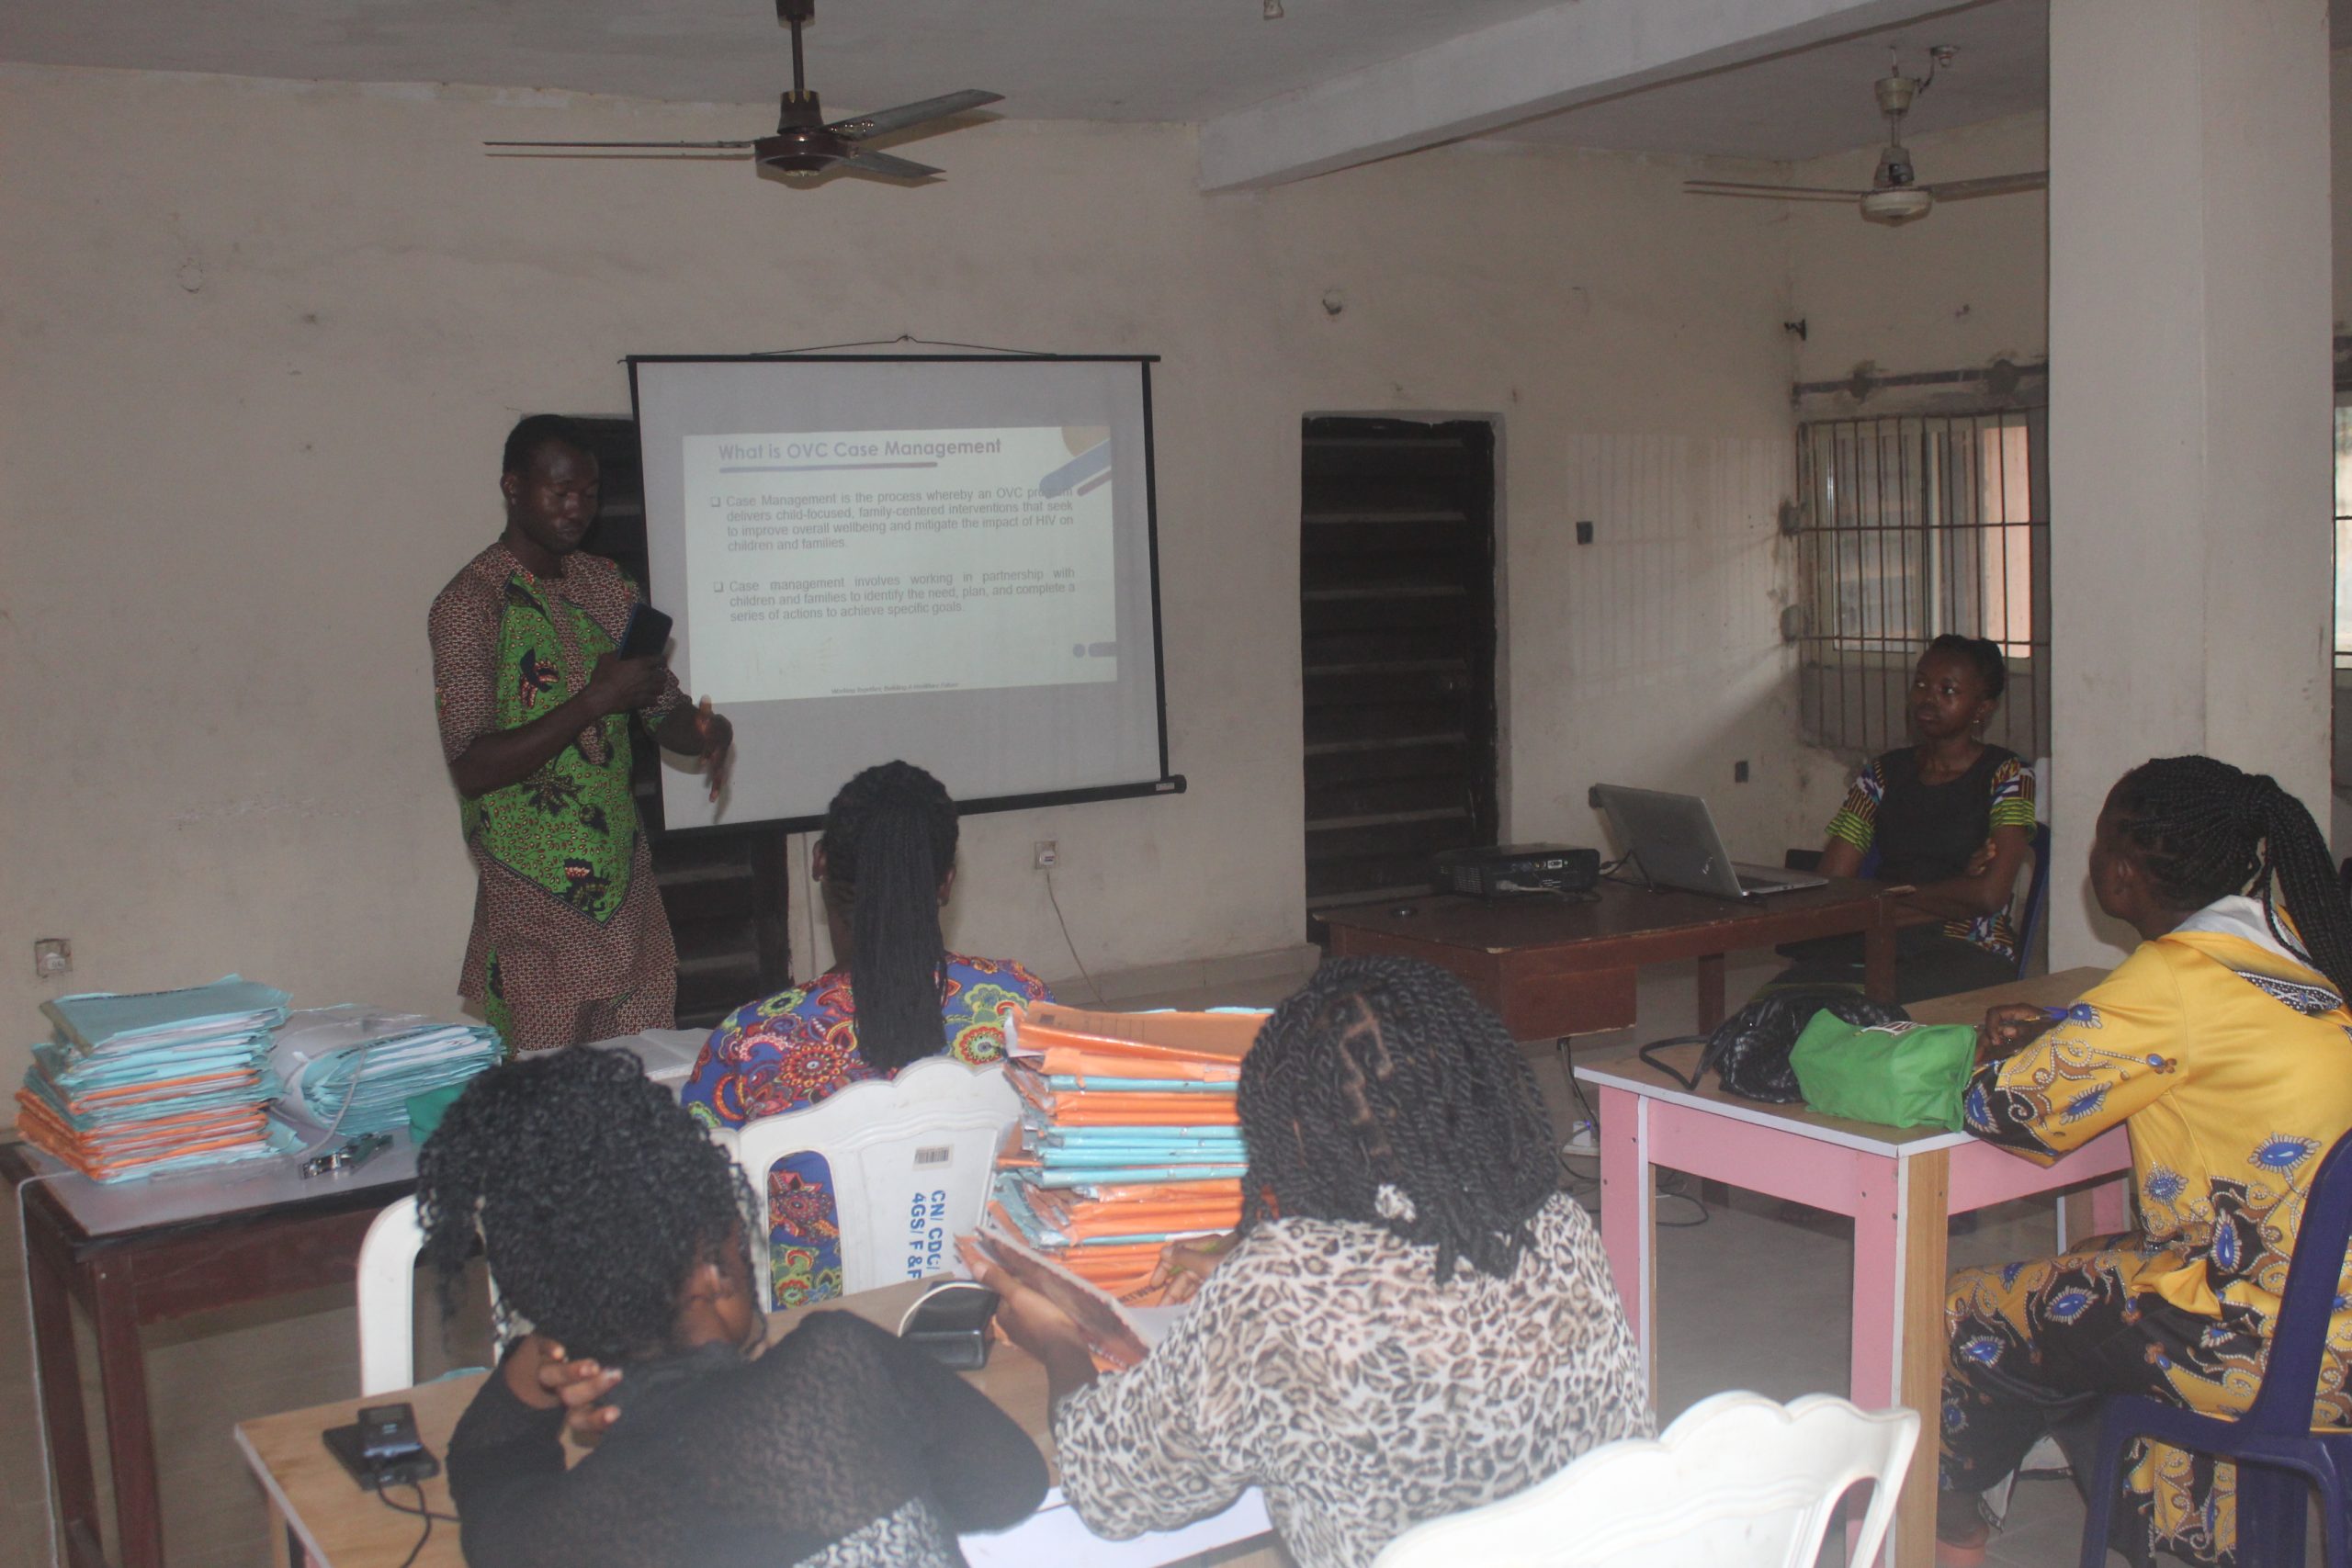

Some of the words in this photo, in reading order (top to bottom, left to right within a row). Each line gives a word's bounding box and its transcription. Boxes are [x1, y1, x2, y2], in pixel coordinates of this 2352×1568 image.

[718, 445, 763, 459] What
[769, 444, 780, 457] is
[787, 442, 829, 458] OVC
[834, 442, 878, 457] Case
[885, 438, 1001, 458] Management
[726, 496, 756, 507] Case
[761, 493, 836, 507] Management
[842, 492, 851, 502] is
[855, 492, 873, 502] the
[877, 491, 922, 504] process
[926, 489, 974, 502] whereby
[978, 491, 992, 499] an
[996, 487, 1023, 499] OVC
[727, 511, 772, 522] delivers
[775, 507, 854, 521] child-focused,
[859, 504, 945, 519] family-centered
[949, 502, 1019, 514] interventions
[1023, 501, 1043, 512] that
[1047, 501, 1073, 511] seek
[728, 526, 739, 536] to
[741, 525, 788, 538] improve
[792, 523, 830, 535] overall
[833, 521, 887, 534] wellbeing
[889, 520, 911, 531] and
[914, 518, 958, 533] mitigate
[962, 517, 979, 529] the
[982, 516, 1019, 529] impact
[1022, 515, 1033, 526] of
[1035, 514, 1057, 525] HIV
[1059, 515, 1074, 525] on
[728, 540, 773, 552] children
[776, 538, 798, 550] and
[729, 581, 760, 592] Case
[770, 577, 845, 592] management
[854, 574, 900, 587] involves
[910, 572, 953, 586] working
[963, 571, 972, 581] in
[982, 568, 1044, 584] partnership
[1053, 567, 1075, 579] with
[729, 595, 775, 607] children
[778, 593, 800, 605] and
[804, 591, 847, 604] families
[850, 591, 861, 602] to
[864, 588, 904, 603] identify
[907, 588, 925, 600] the
[992, 583, 1013, 596] and
[1015, 582, 1065, 596] complete
[1068, 582, 1075, 592] a
[729, 610, 765, 622] series
[768, 609, 780, 621] of
[783, 607, 823, 619] actions
[826, 606, 837, 617] to
[840, 604, 884, 617] achieve
[887, 603, 929, 617] specific
[910, 1192, 927, 1234] 4GS/
[930, 1190, 946, 1220] CN/
[909, 1240, 923, 1250] F
